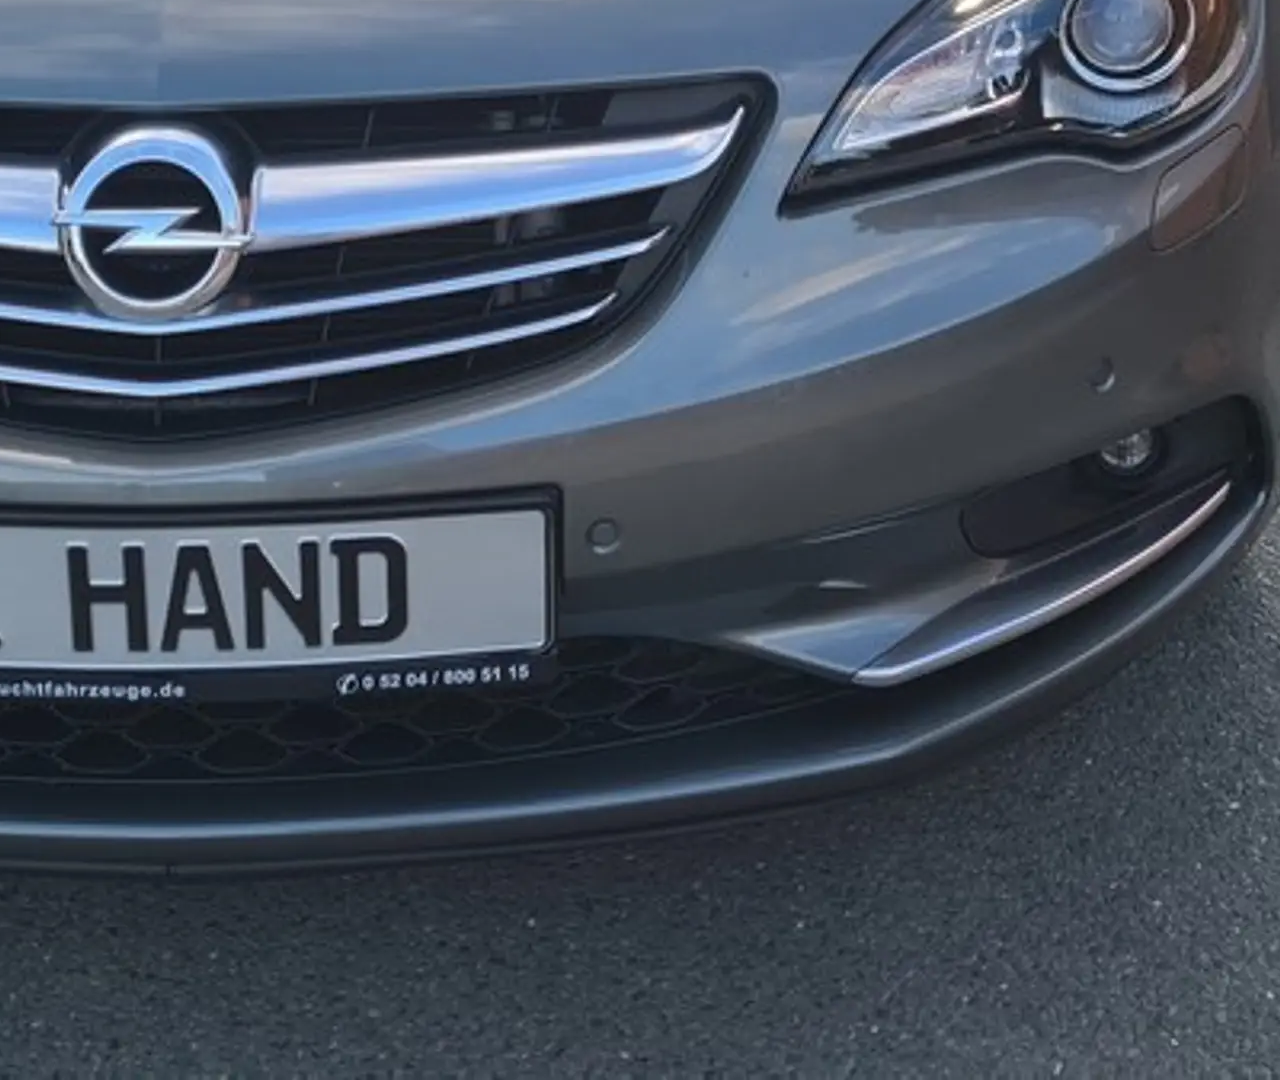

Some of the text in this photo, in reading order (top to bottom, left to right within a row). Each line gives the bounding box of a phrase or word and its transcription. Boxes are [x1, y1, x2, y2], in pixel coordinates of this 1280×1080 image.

[66, 534, 408, 653] HAND
[405, 671, 428, 688] 04
[508, 663, 530, 681] 15
